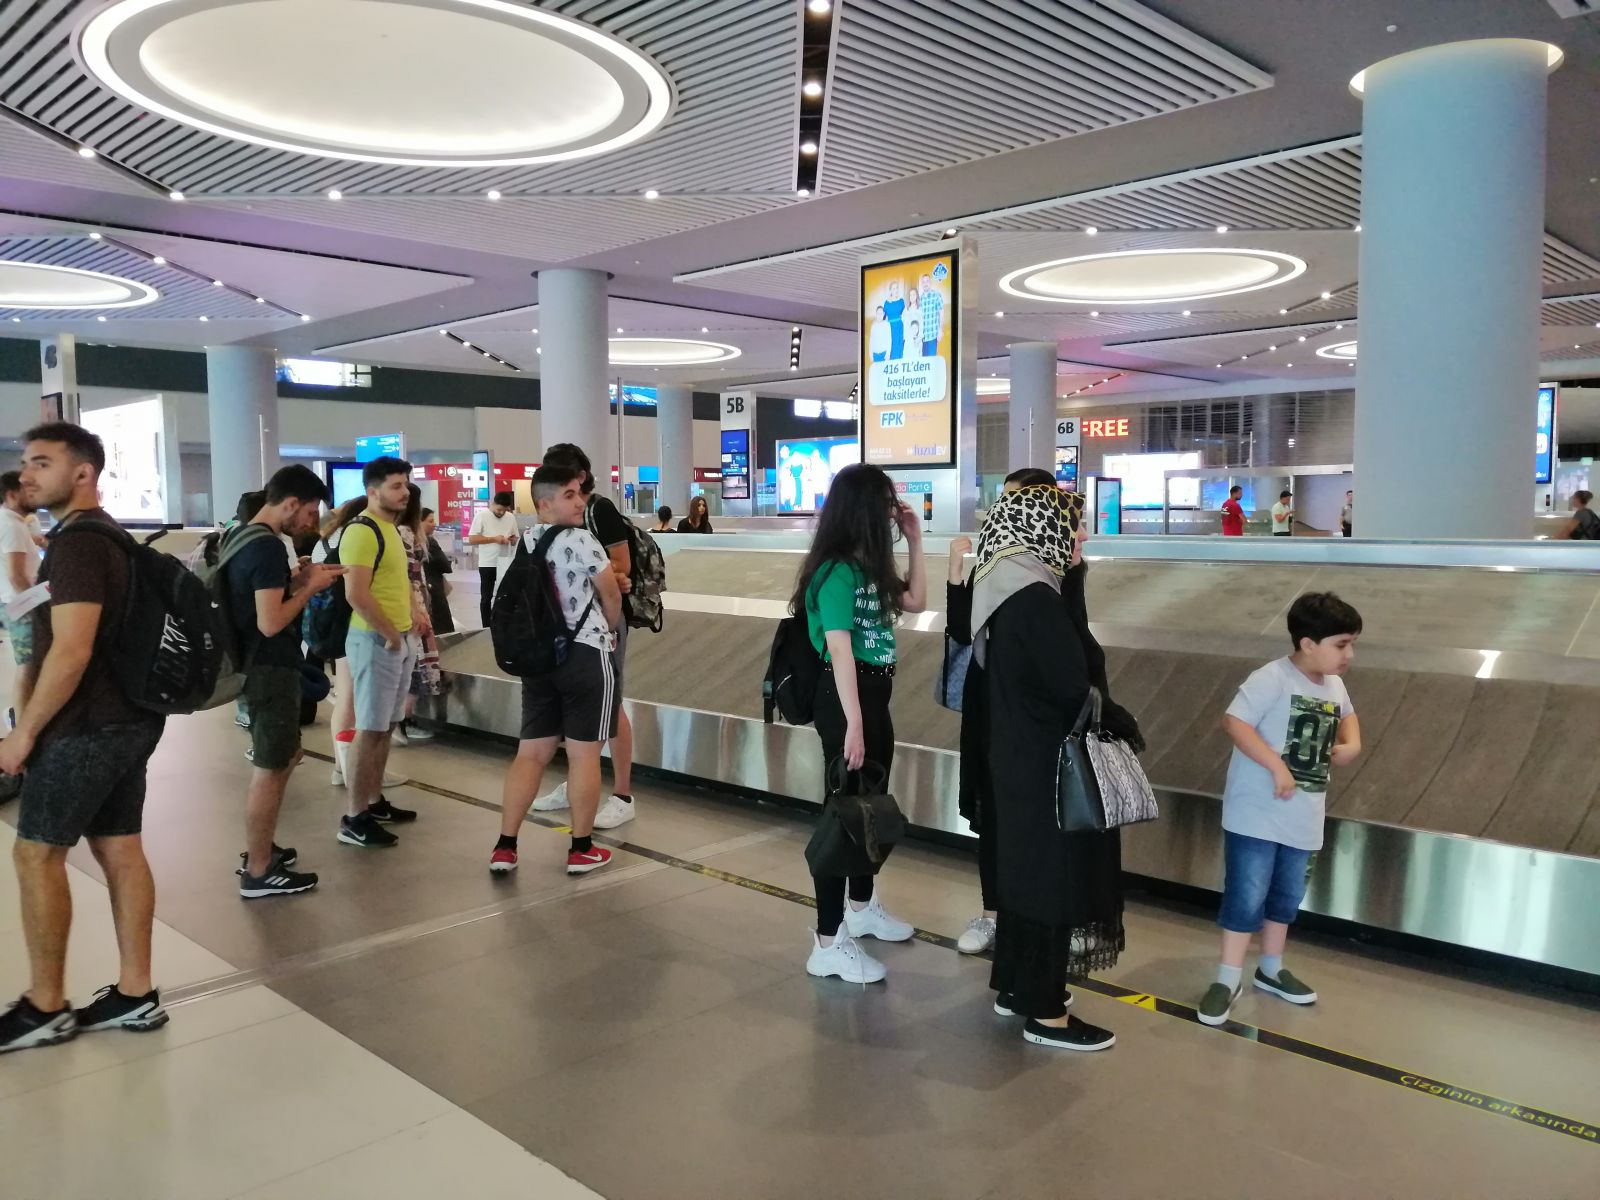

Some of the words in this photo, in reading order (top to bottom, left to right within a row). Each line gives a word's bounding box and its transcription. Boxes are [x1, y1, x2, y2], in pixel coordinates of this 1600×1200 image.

[883, 364, 899, 374] 416
[901, 361, 930, 373] TL'den
[887, 376, 927, 389] başlayan
[883, 387, 930, 400] taksitlerle!
[726, 397, 744, 413] 5B
[881, 412, 903, 426] FPK
[1057, 422, 1074, 434] 6B
[1400, 1075, 1483, 1105] Çizginin
[1488, 1102, 1597, 1138] arkasında
